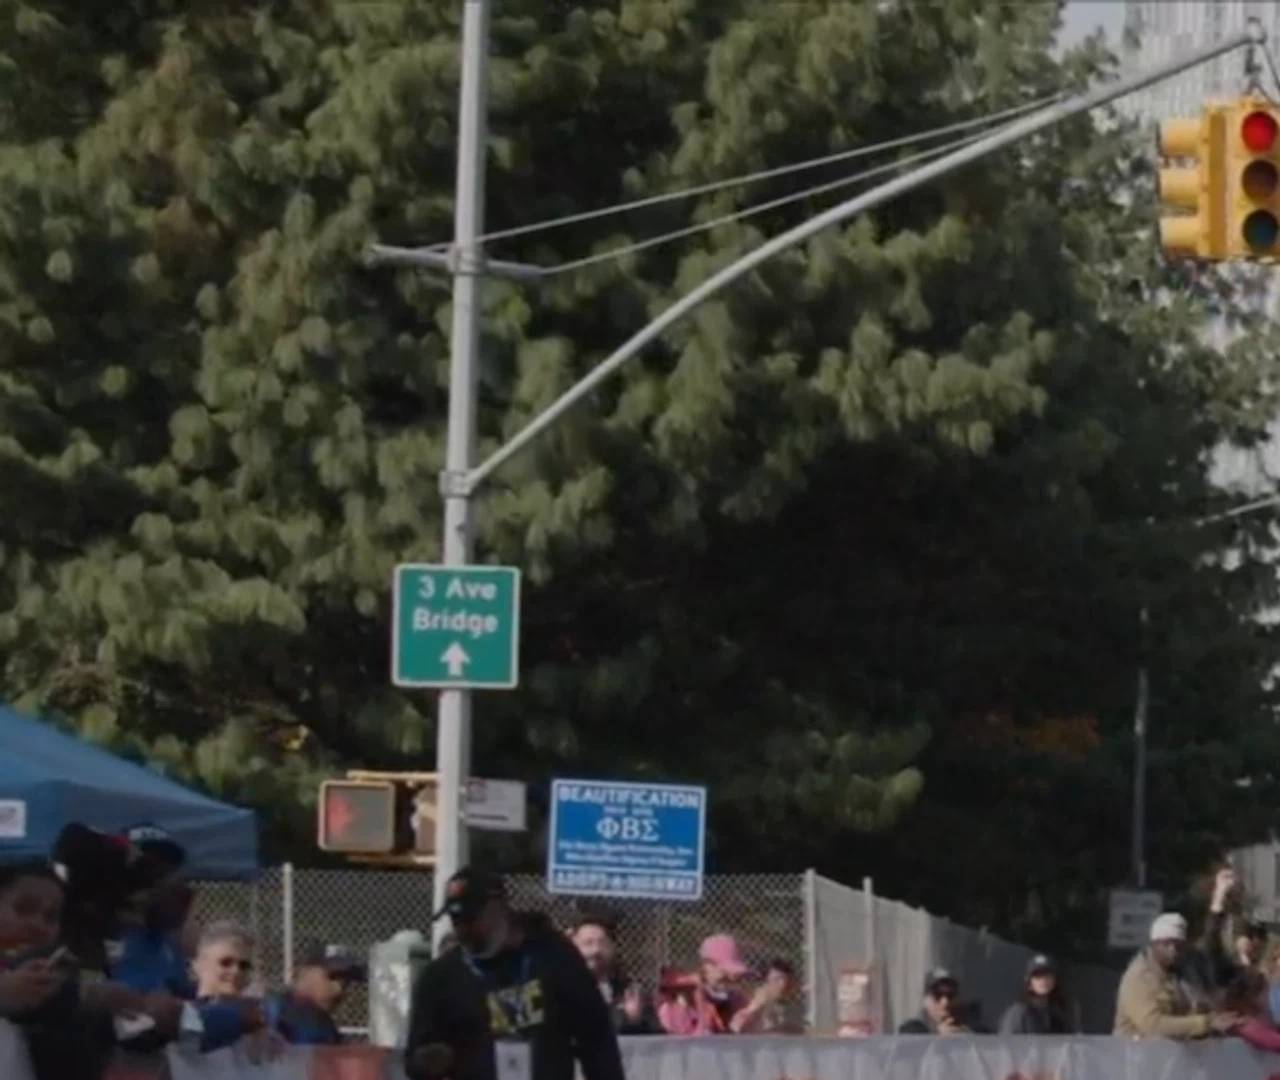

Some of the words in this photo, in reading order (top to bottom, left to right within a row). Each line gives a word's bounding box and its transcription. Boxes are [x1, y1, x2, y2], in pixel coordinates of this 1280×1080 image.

[418, 576, 435, 598] 3
[445, 577, 497, 599] Ave
[412, 608, 499, 638] Bridge
[559, 785, 699, 808] BEAUTIFICATION
